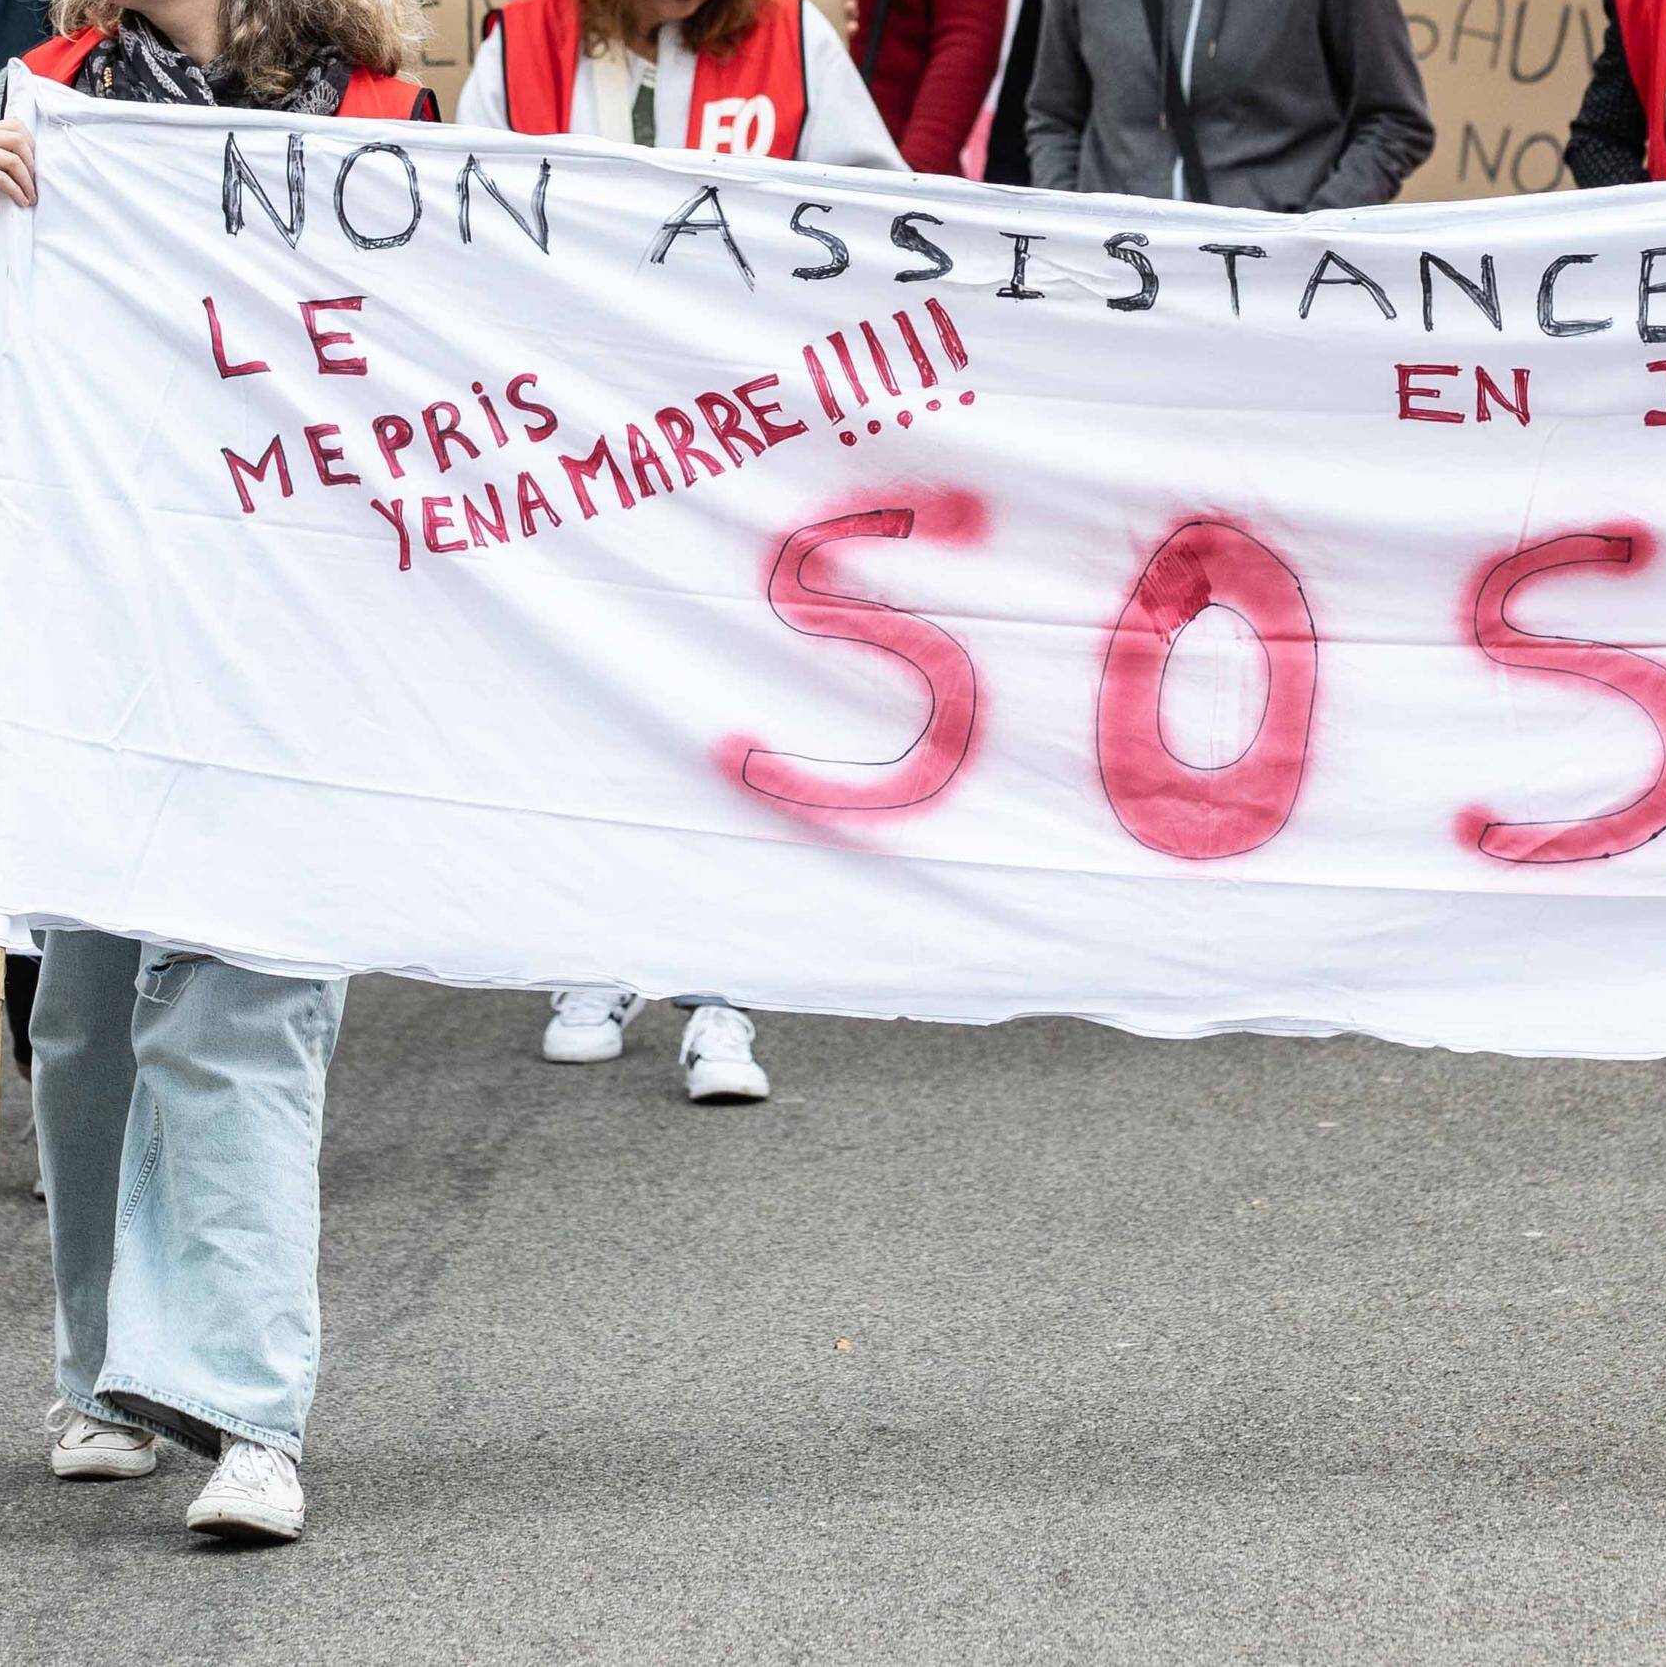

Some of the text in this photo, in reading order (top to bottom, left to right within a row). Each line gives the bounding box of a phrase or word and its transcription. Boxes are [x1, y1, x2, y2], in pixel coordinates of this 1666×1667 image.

[220, 130, 551, 255] NON
[201, 294, 369, 380] LE
[1394, 363, 1532, 427] EN
